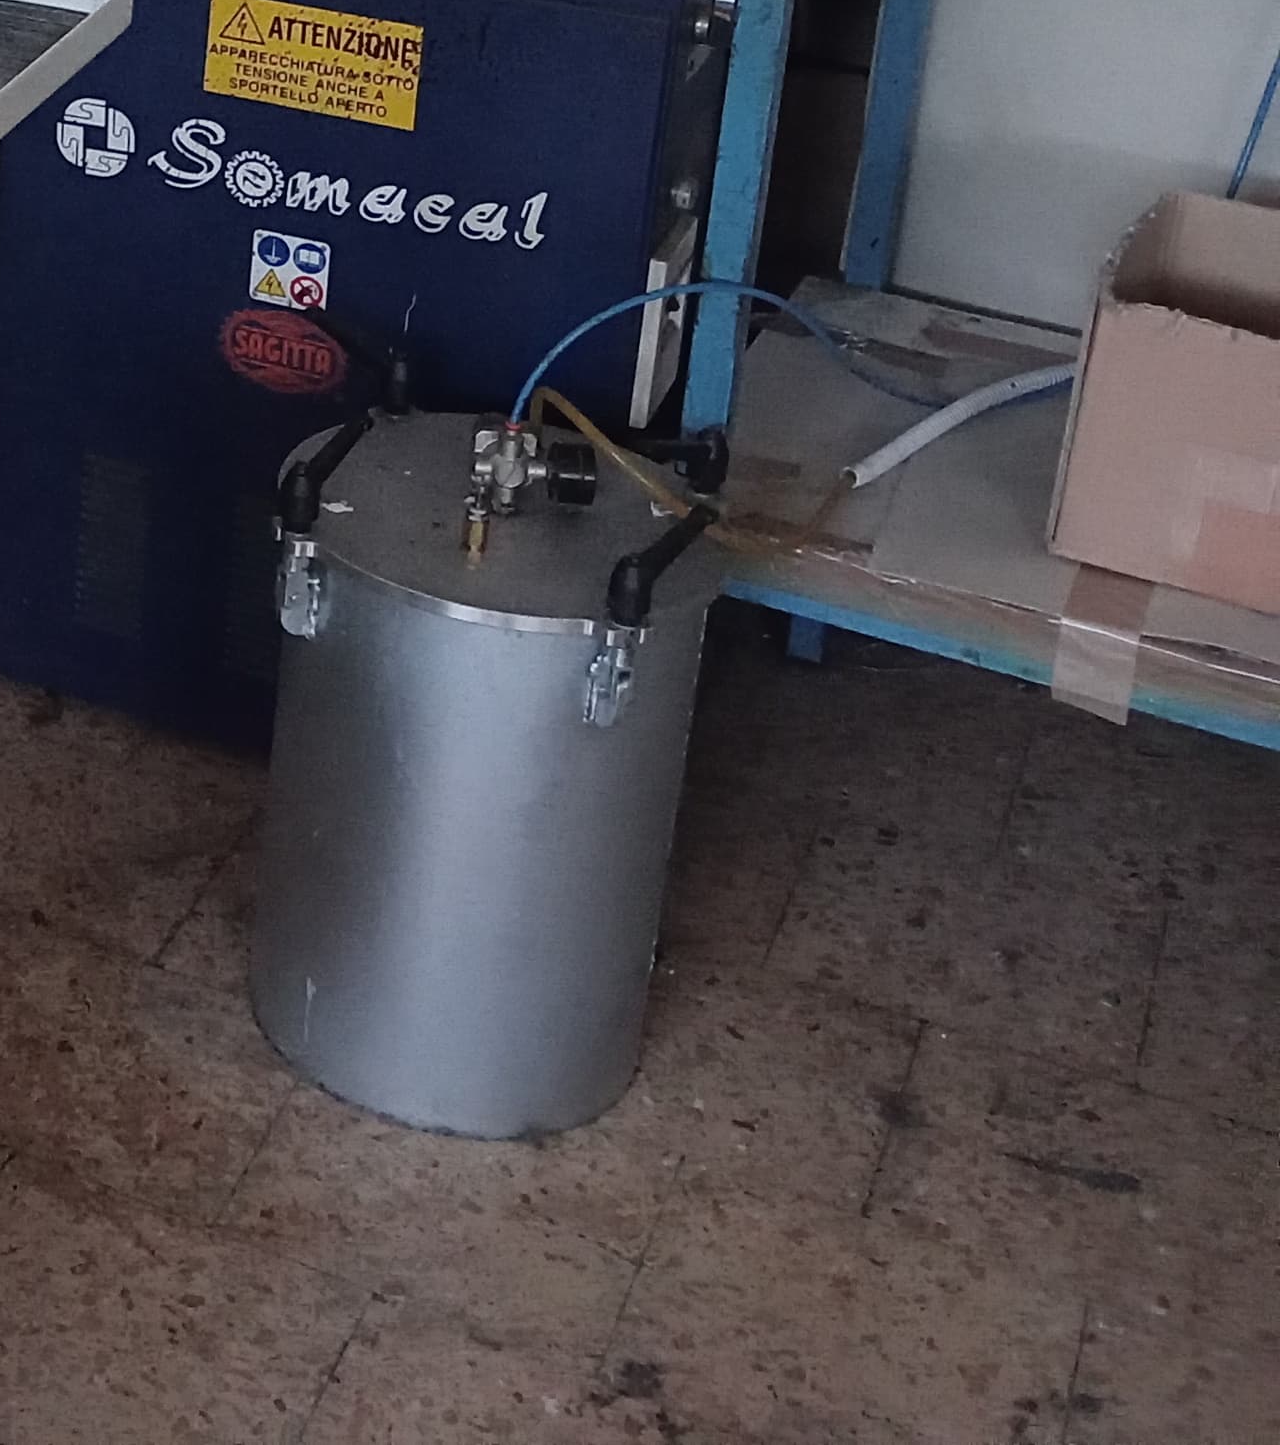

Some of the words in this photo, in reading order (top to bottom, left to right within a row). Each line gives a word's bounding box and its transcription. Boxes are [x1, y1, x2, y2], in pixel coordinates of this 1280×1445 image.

[268, 15, 422, 65] ATTENZIONE
[209, 42, 360, 80] APPARECCHIATURA
[362, 70, 415, 92] SOTTO
[235, 62, 308, 88] TENSIONE
[315, 78, 368, 99] ANCHE
[374, 89, 384, 101] A
[229, 76, 319, 104] SPORTELLO
[324, 95, 388, 118] APERTO
[147, 118, 551, 249] Somacal
[235, 328, 332, 378] SAGITTA
